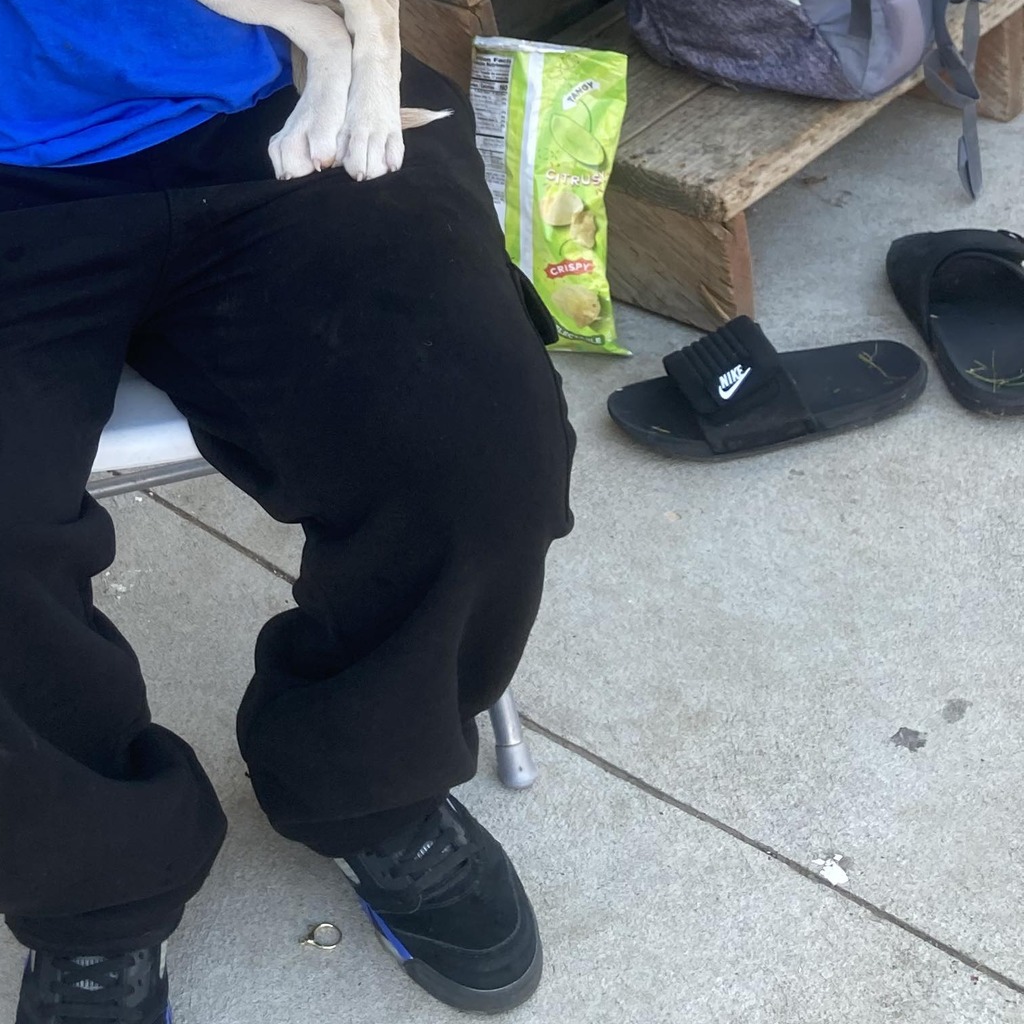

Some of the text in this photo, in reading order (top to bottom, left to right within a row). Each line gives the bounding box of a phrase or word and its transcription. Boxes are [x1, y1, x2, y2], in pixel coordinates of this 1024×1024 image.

[567, 81, 594, 102] TANGY
[546, 169, 603, 186] CITRUS
[550, 261, 589, 275] CRISPY
[719, 364, 744, 389] NIKE
